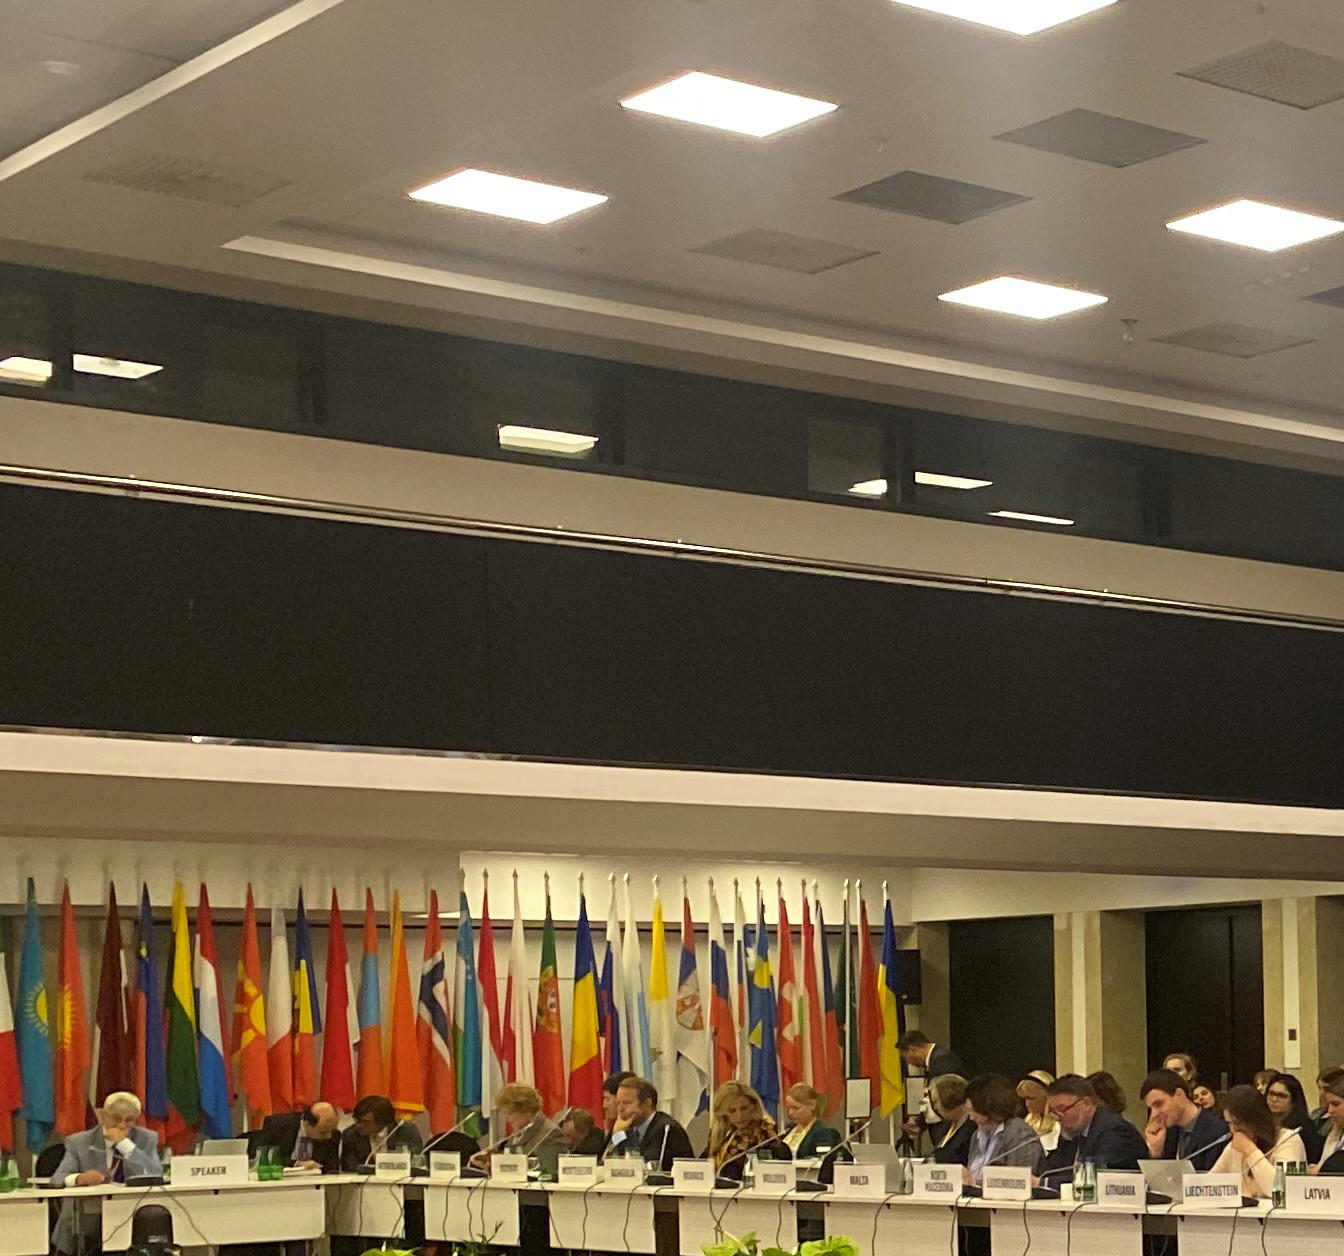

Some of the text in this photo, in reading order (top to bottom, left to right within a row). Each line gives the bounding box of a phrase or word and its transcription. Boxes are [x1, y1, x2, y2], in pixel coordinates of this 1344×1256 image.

[190, 1165, 227, 1177] SPEAKER
[1184, 1184, 1239, 1198] LIECHTENSTEIN
[1304, 1187, 1331, 1200] LATVIA
